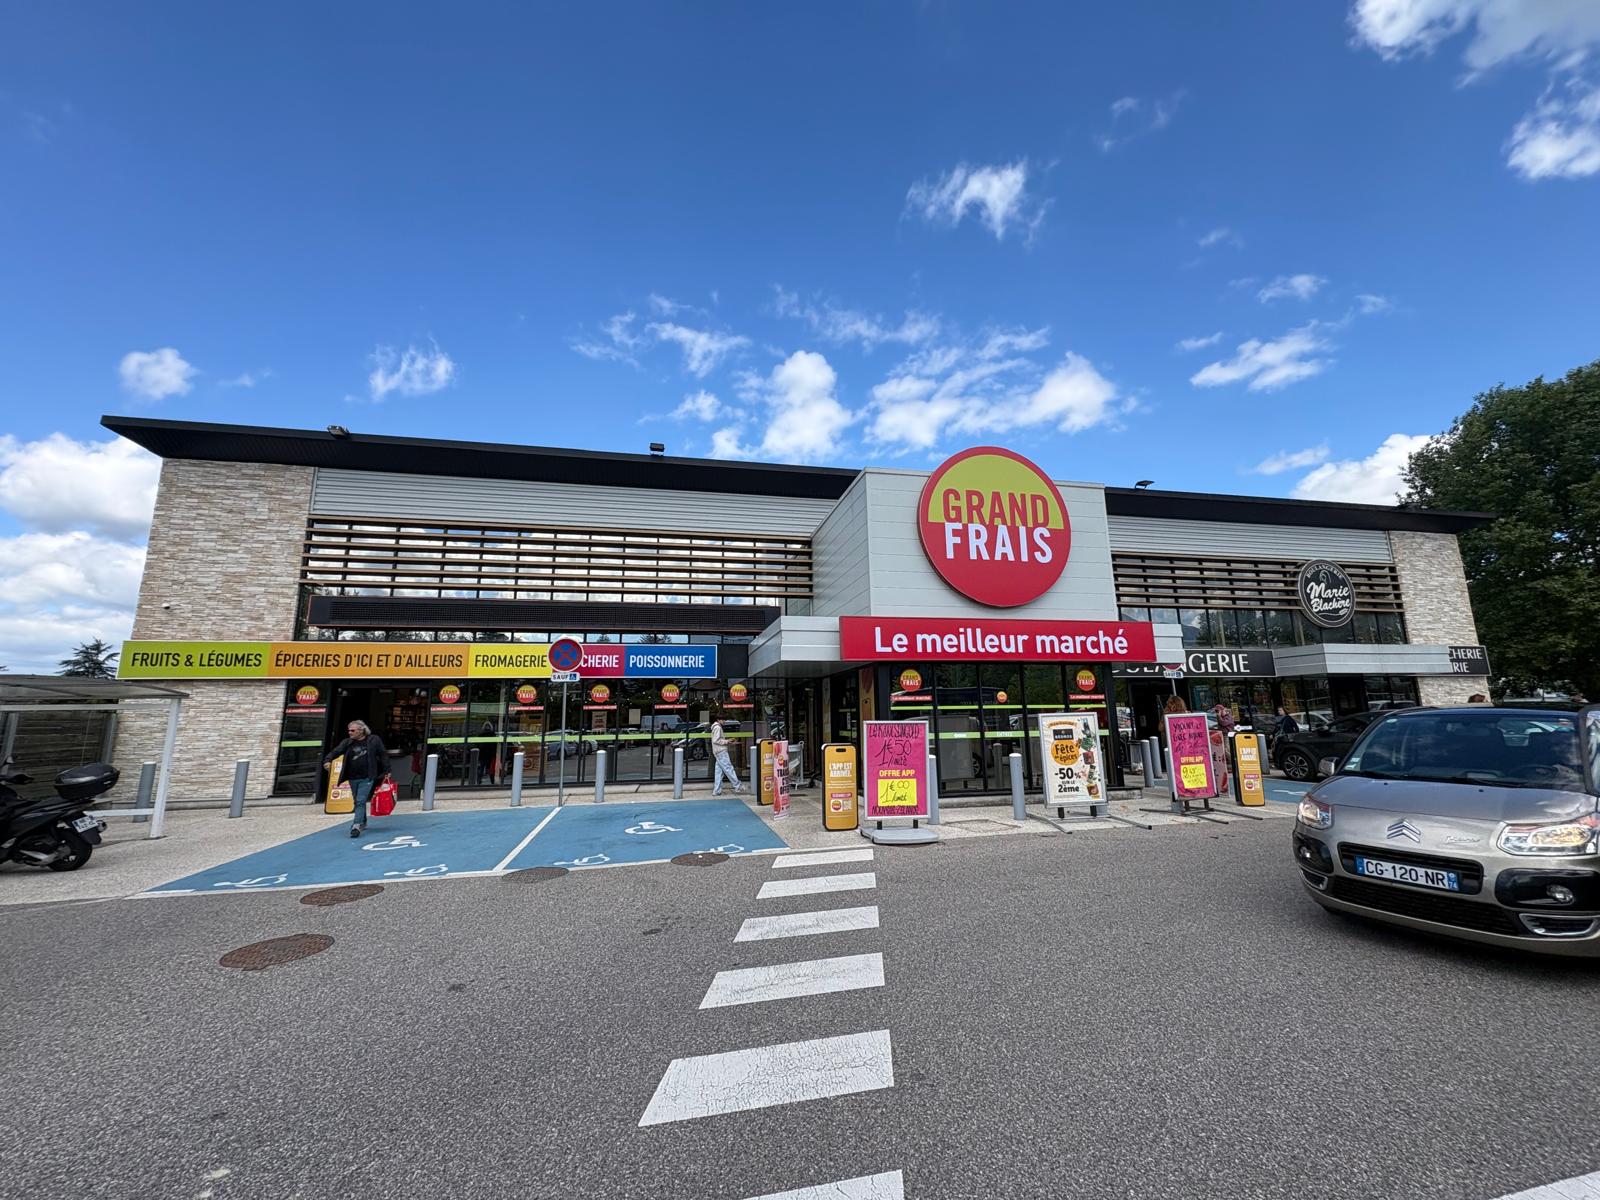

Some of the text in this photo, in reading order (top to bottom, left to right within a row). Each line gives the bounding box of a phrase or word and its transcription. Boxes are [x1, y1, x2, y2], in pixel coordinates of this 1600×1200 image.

[943, 488, 1049, 528] GRAND
[944, 522, 1053, 564] FRAIS
[1306, 582, 1350, 599] Marie
[1311, 598, 1351, 612] Blachère
[875, 626, 1128, 654] Le meilleur marché
[131, 650, 262, 667] FRUITS & LÉGUMES
[275, 650, 463, 668] ÉPICERIES D'ICI ET D'AILLEURS
[474, 654, 547, 668] FROMAGERIE
[580, 654, 619, 668] CHERIE
[630, 655, 705, 668] POISSONNERIE
[1055, 744, 1074, 755] Fête
[1060, 753, 1078, 763] épices
[879, 769, 916, 777] OFFRE APP
[1058, 784, 1080, 793] 2ème
[1366, 861, 1446, 887] CG-120-NR
